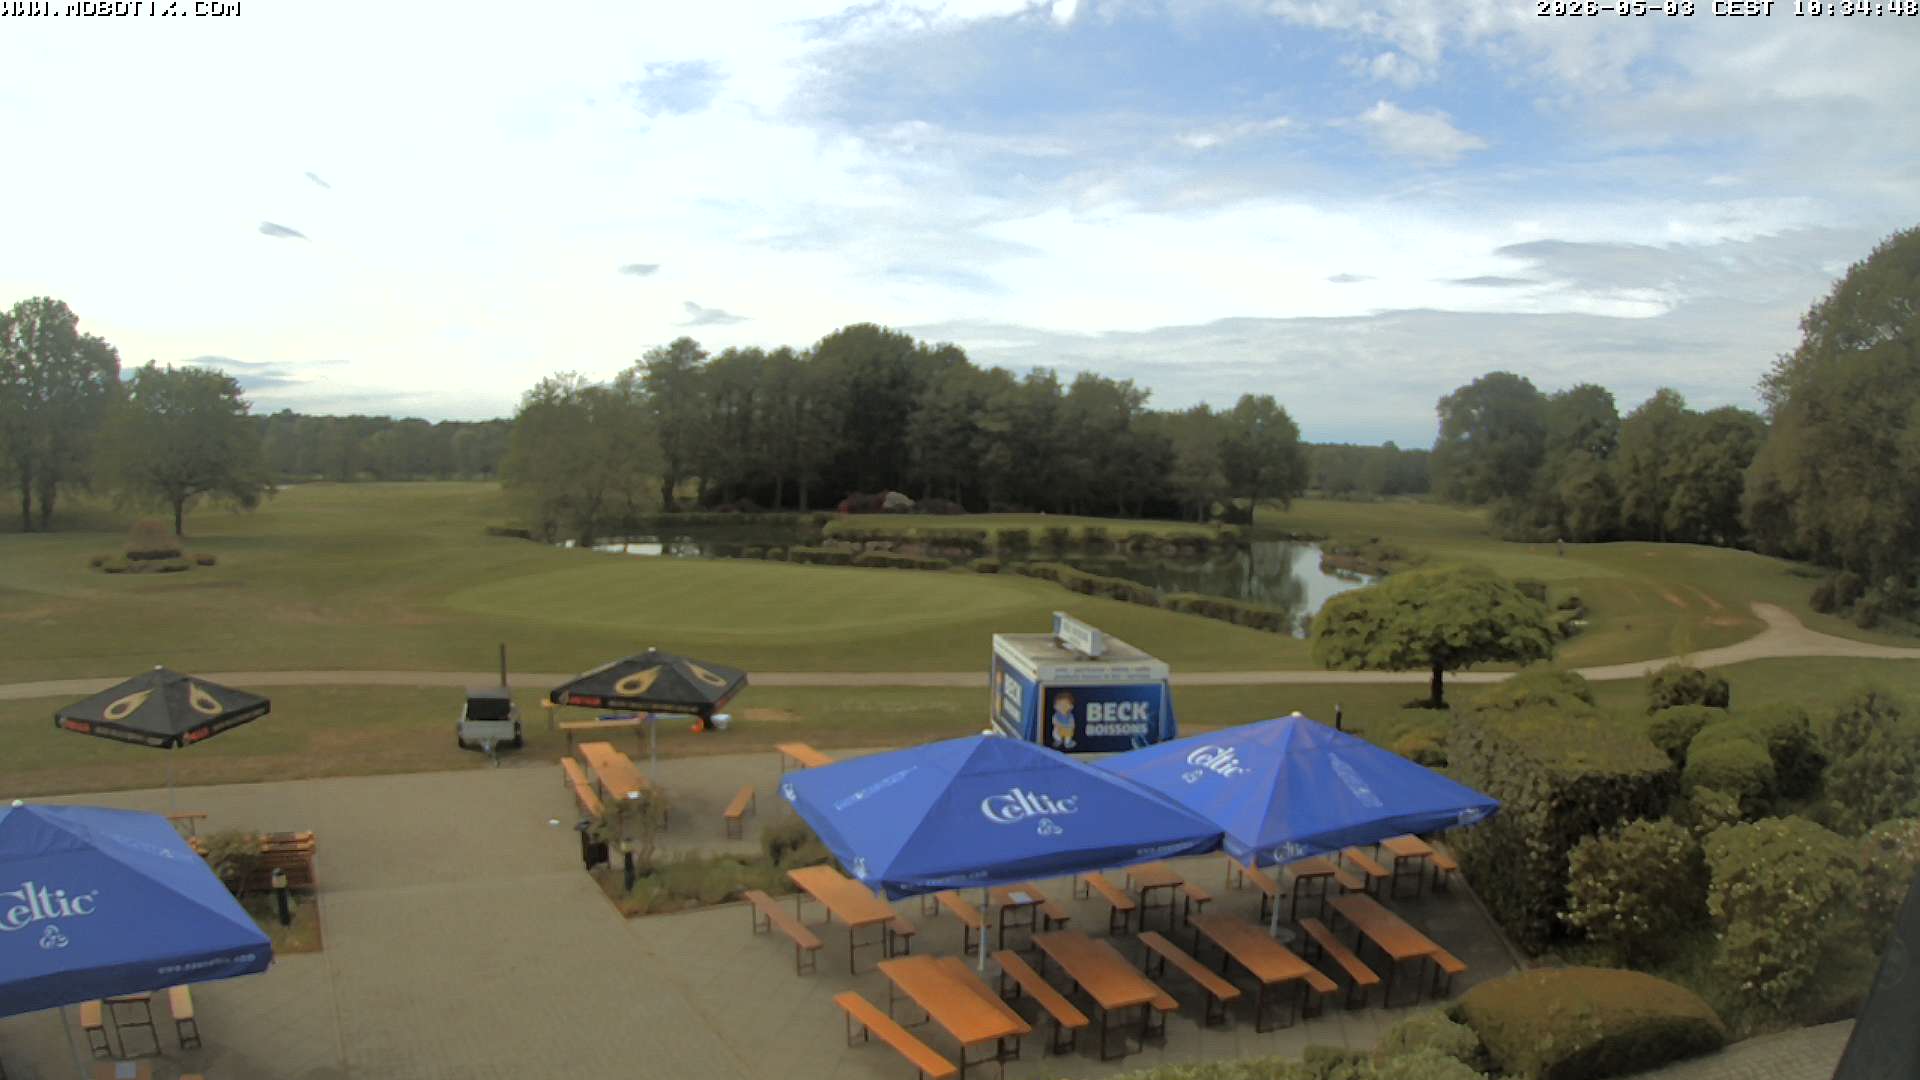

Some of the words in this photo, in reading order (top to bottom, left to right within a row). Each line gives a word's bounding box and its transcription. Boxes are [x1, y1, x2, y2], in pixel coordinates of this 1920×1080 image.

[1086, 702, 1149, 722] BECK
[1085, 722, 1149, 737] BOISSONS
[1187, 745, 1244, 778] Celtic
[981, 787, 1078, 822] Celtic
